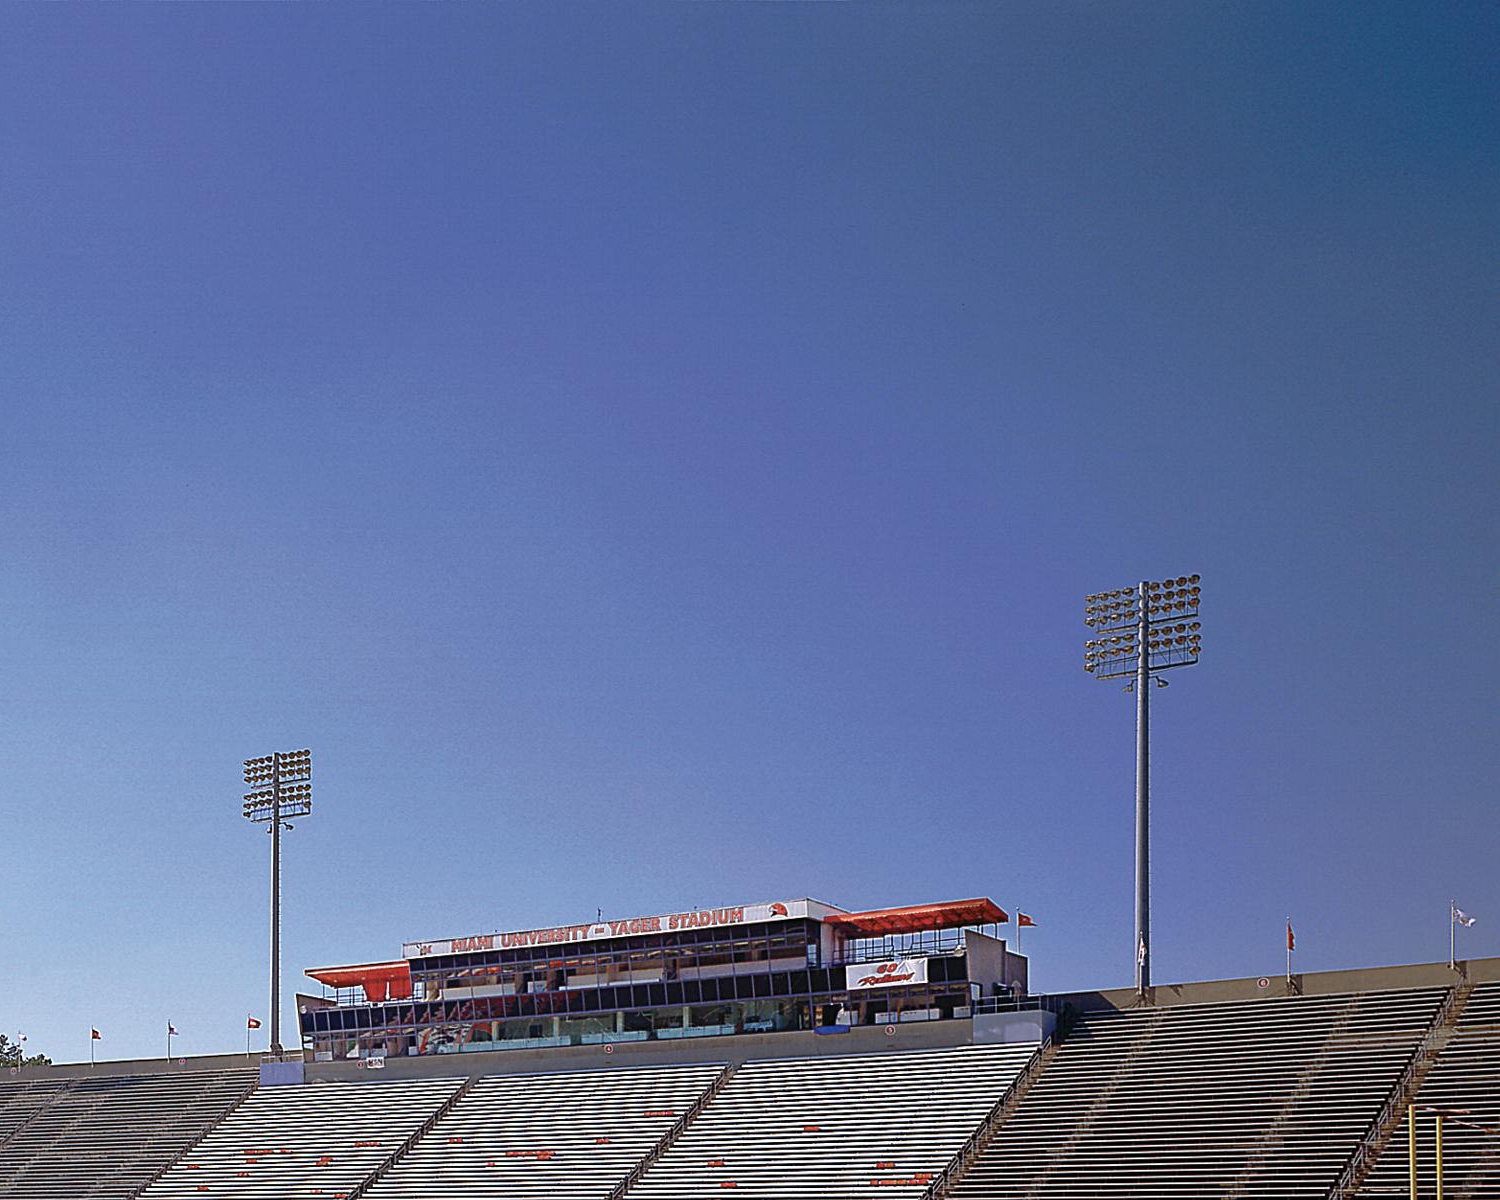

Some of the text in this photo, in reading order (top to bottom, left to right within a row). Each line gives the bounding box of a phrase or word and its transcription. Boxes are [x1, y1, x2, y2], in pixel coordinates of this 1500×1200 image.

[451, 935, 494, 952] MIAMI
[500, 925, 589, 948] UNIVERSITY
[668, 906, 745, 929] STADIUM
[877, 963, 898, 974] GO
